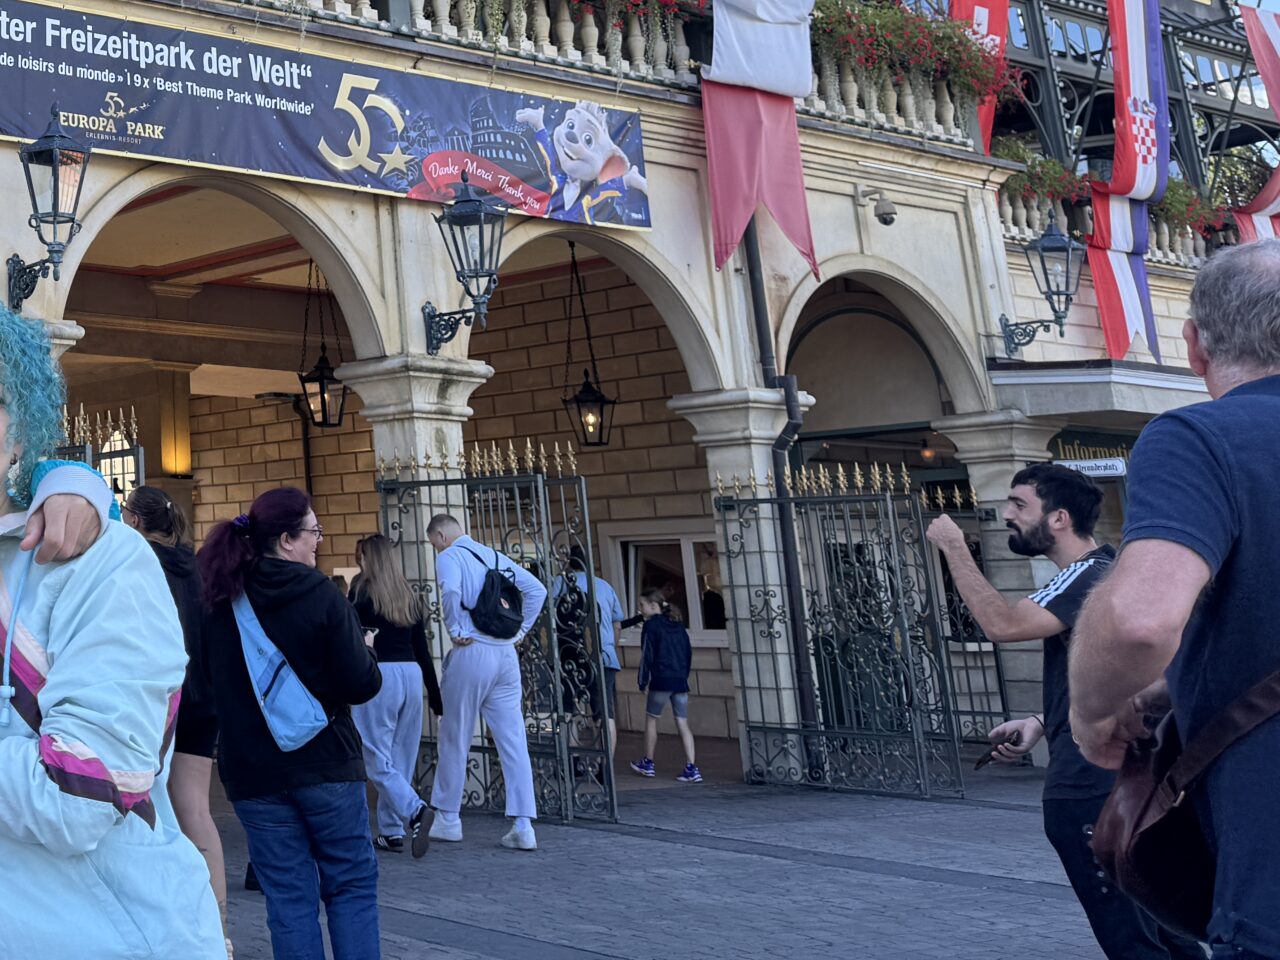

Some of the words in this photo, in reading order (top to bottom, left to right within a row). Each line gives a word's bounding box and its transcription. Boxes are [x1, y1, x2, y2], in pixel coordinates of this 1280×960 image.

[45, 17, 197, 71] Freizeitpark
[203, 46, 242, 78] der
[0, 52, 15, 67] de
[18, 54, 55, 73] loisirs
[58, 61, 73, 76] du
[134, 72, 141, 87] 9
[142, 77, 150, 89] x
[185, 81, 224, 100] Theme
[227, 88, 253, 105] Park
[59, 111, 117, 133] EUROPA
[126, 121, 165, 139] PARK
[428, 158, 460, 178] Danke
[463, 158, 493, 181] Merci
[497, 173, 525, 202] Thank
[523, 196, 541, 210] you
[1057, 438, 1130, 462] Informati
